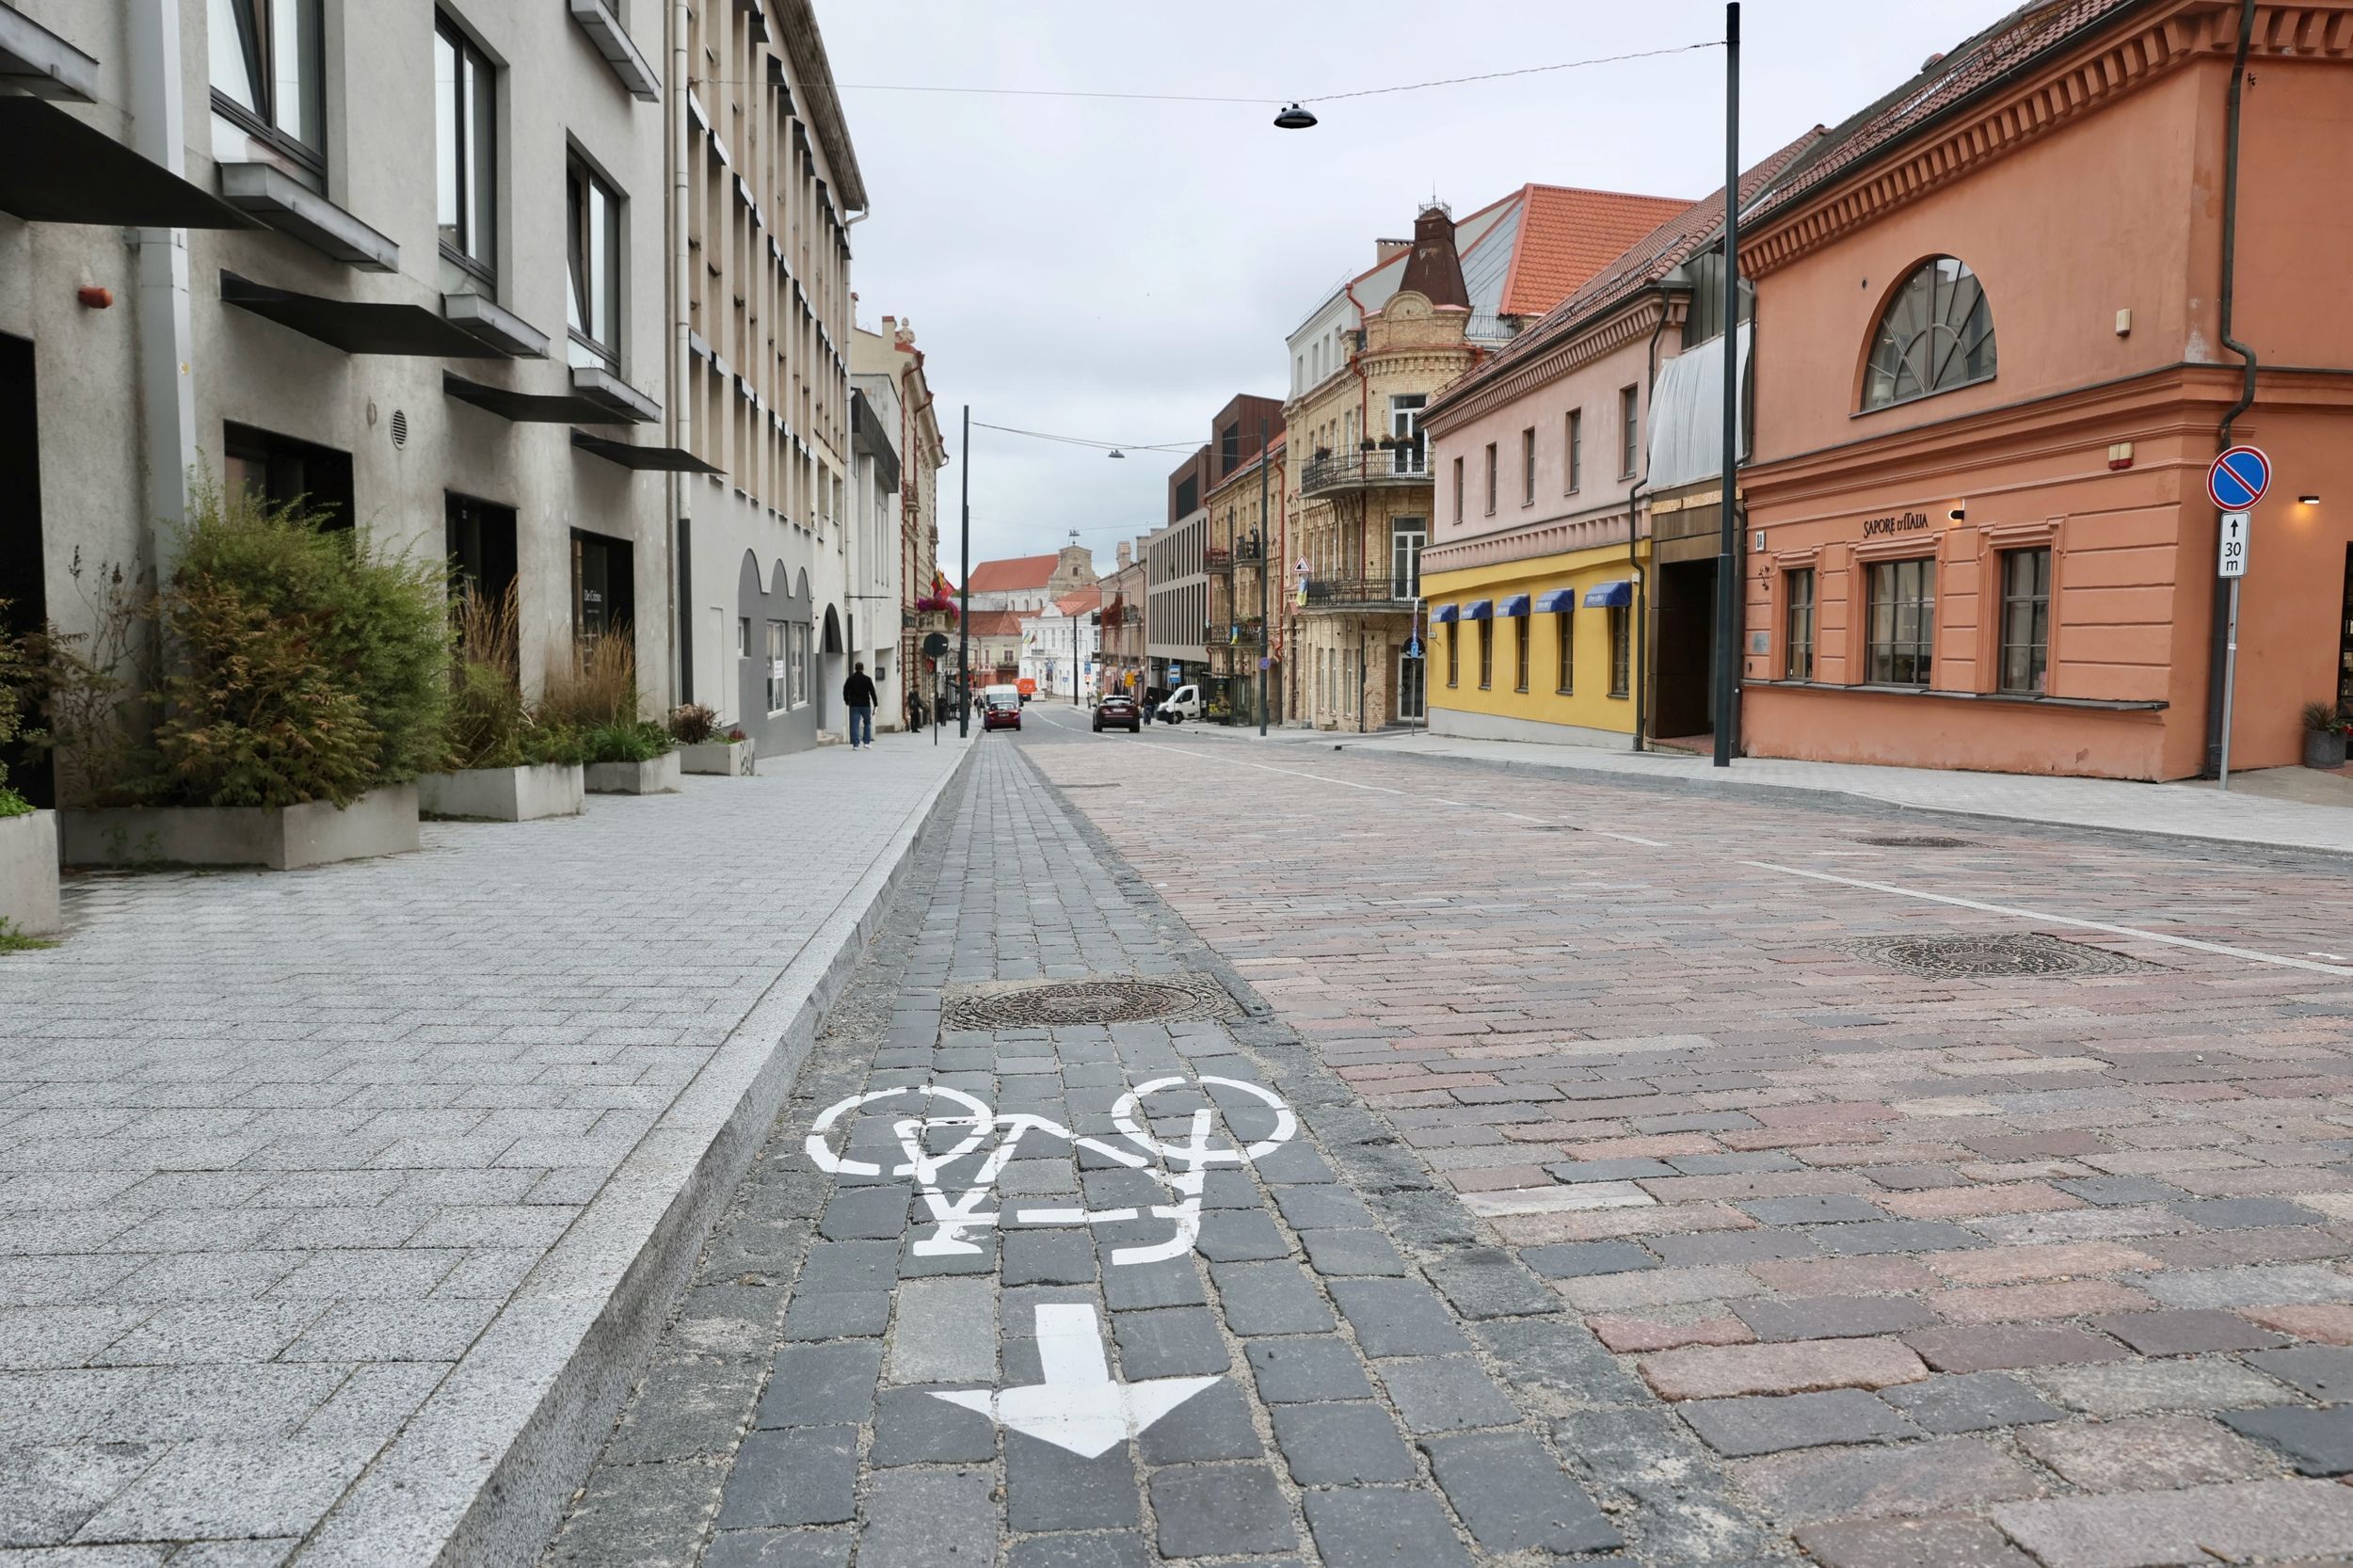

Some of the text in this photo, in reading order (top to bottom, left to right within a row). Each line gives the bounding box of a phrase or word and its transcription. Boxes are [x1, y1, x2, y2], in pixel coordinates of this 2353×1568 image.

[1864, 518, 1895, 538] SAPORE
[2225, 542, 2242, 557] 30
[2226, 560, 2238, 571] m
